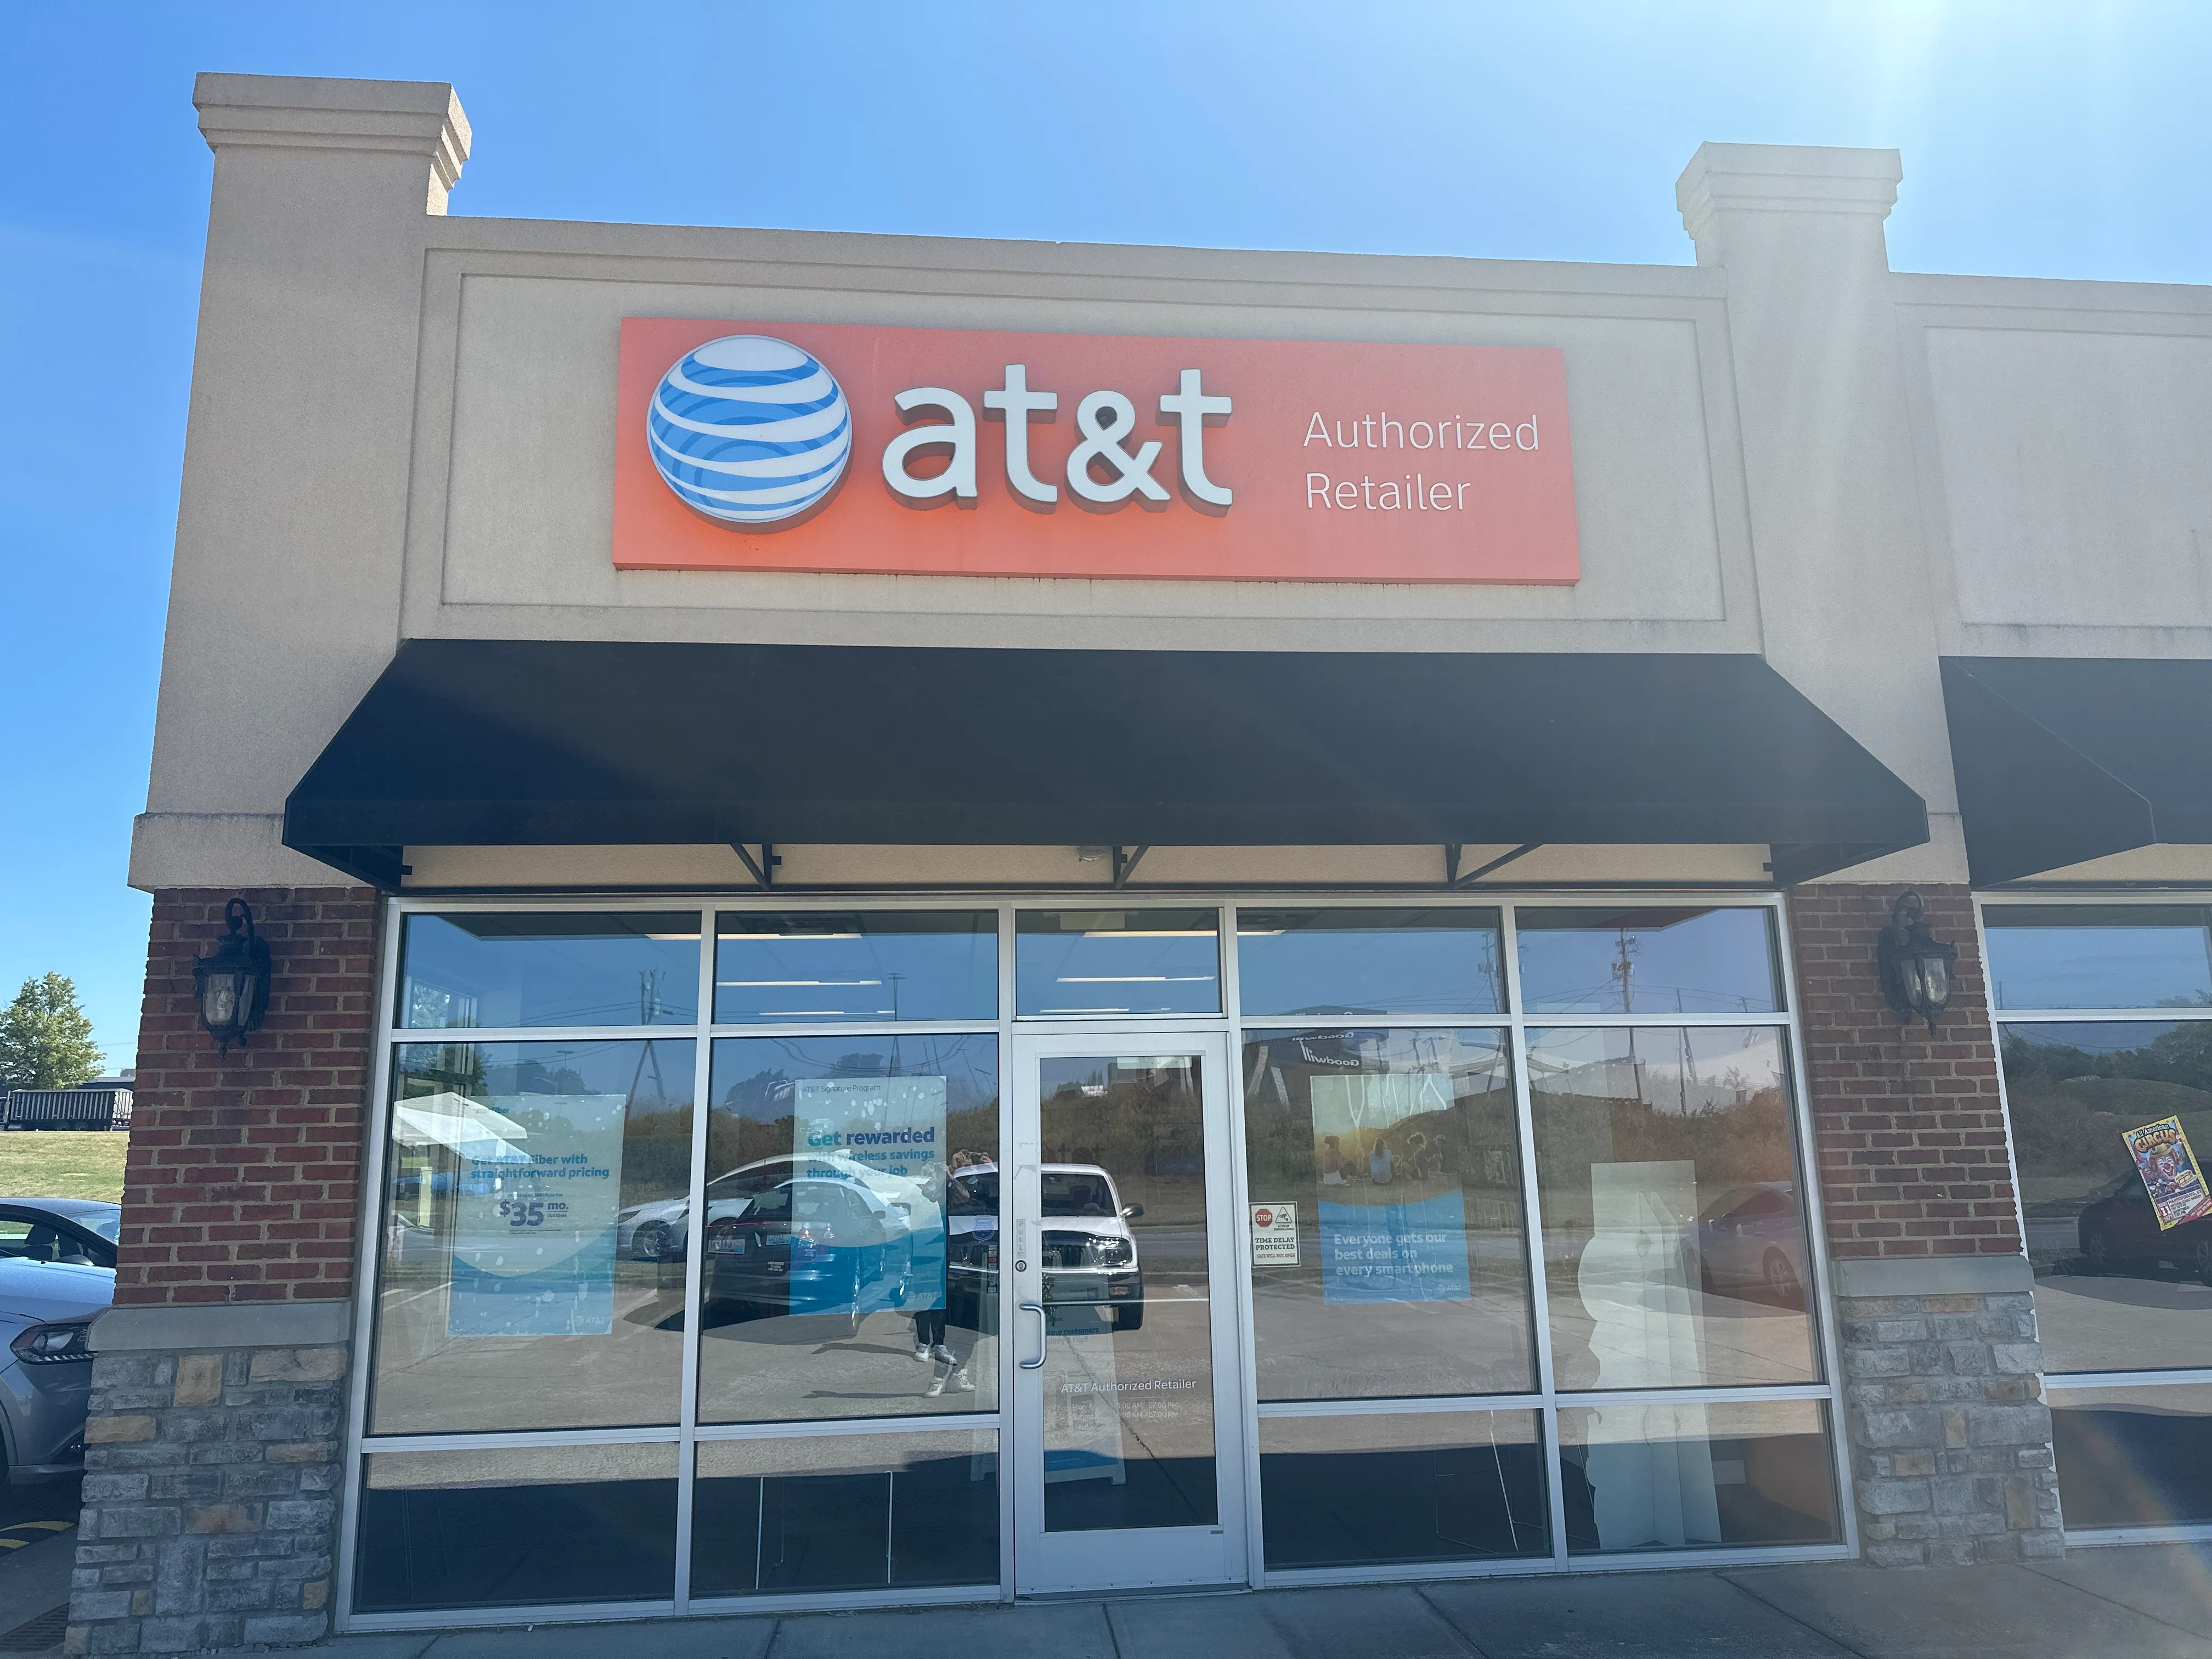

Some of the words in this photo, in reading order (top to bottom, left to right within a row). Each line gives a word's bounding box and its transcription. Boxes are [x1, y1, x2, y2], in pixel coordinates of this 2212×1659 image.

[881, 363, 1233, 508] at&t
[1303, 411, 1539, 451] Authorized
[1306, 472, 1471, 511] Retailer
[821, 1085, 851, 1094] Signature
[808, 1131, 842, 1147] Get
[847, 1126, 935, 1145] rewarded
[2144, 1124, 2170, 1135] American
[2135, 1129, 2176, 1152] CIRCUS
[472, 1155, 494, 1165] Get
[496, 1154, 527, 1164] AT&T
[529, 1154, 558, 1165] Fiber
[561, 1154, 588, 1164] with
[808, 1153, 835, 1163] with
[836, 1150, 887, 1163] wireless
[889, 1148, 935, 1161] savings
[470, 1167, 567, 1180] straightforward
[568, 1166, 610, 1180] pricing
[806, 1167, 856, 1180] through
[860, 1168, 888, 1180] your
[888, 1165, 908, 1179] job
[499, 1199, 544, 1226] $35
[2160, 1205, 2171, 1216] 11
[1334, 1233, 1393, 1247] Everyone
[1396, 1234, 1424, 1246] gets
[1426, 1233, 1447, 1243] our
[1335, 1249, 1363, 1260] best
[1366, 1247, 1398, 1260] deals
[1401, 1249, 1418, 1259] on
[1336, 1265, 1373, 1278] every
[1375, 1262, 1454, 1277] smartphone
[917, 1292, 938, 1300] AT&T
[1060, 1383, 1089, 1393] AT&T
[1091, 1381, 1152, 1392] Authorized
[1154, 1379, 1197, 1390] Retailer
